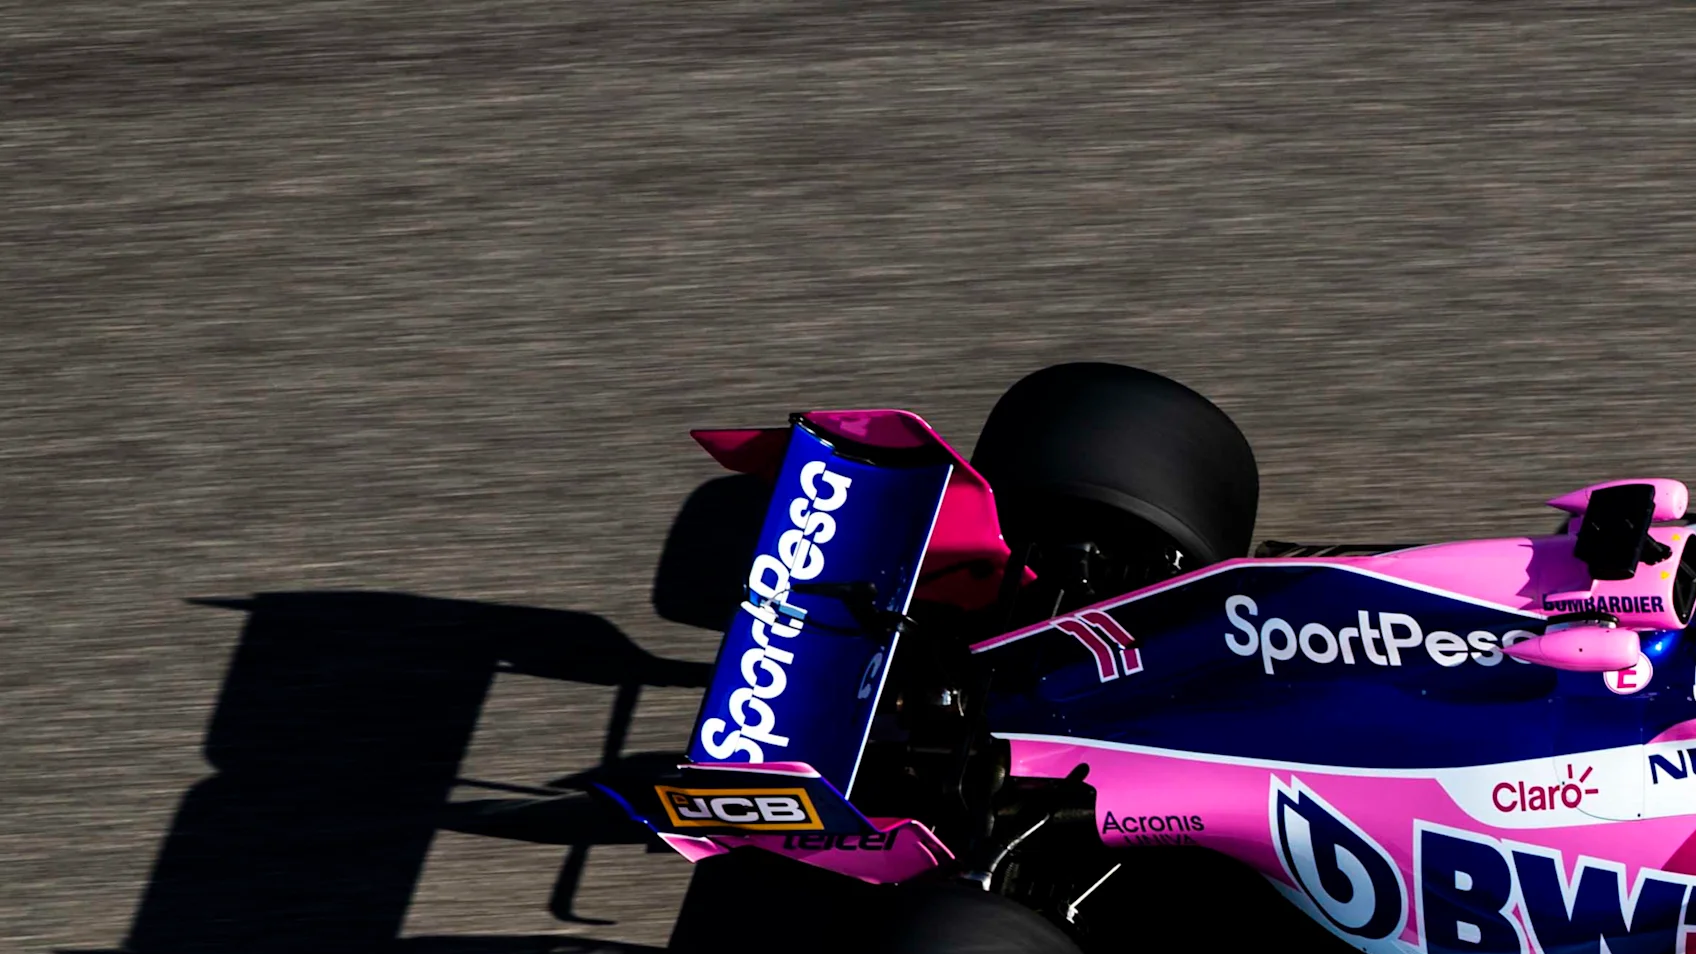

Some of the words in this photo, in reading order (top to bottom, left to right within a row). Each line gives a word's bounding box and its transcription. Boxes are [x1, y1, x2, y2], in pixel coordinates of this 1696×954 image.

[701, 461, 852, 764] SportPesa
[679, 797, 806, 822] JCB
[1493, 777, 1585, 813] Claro
[1102, 811, 1205, 834] Acronis
